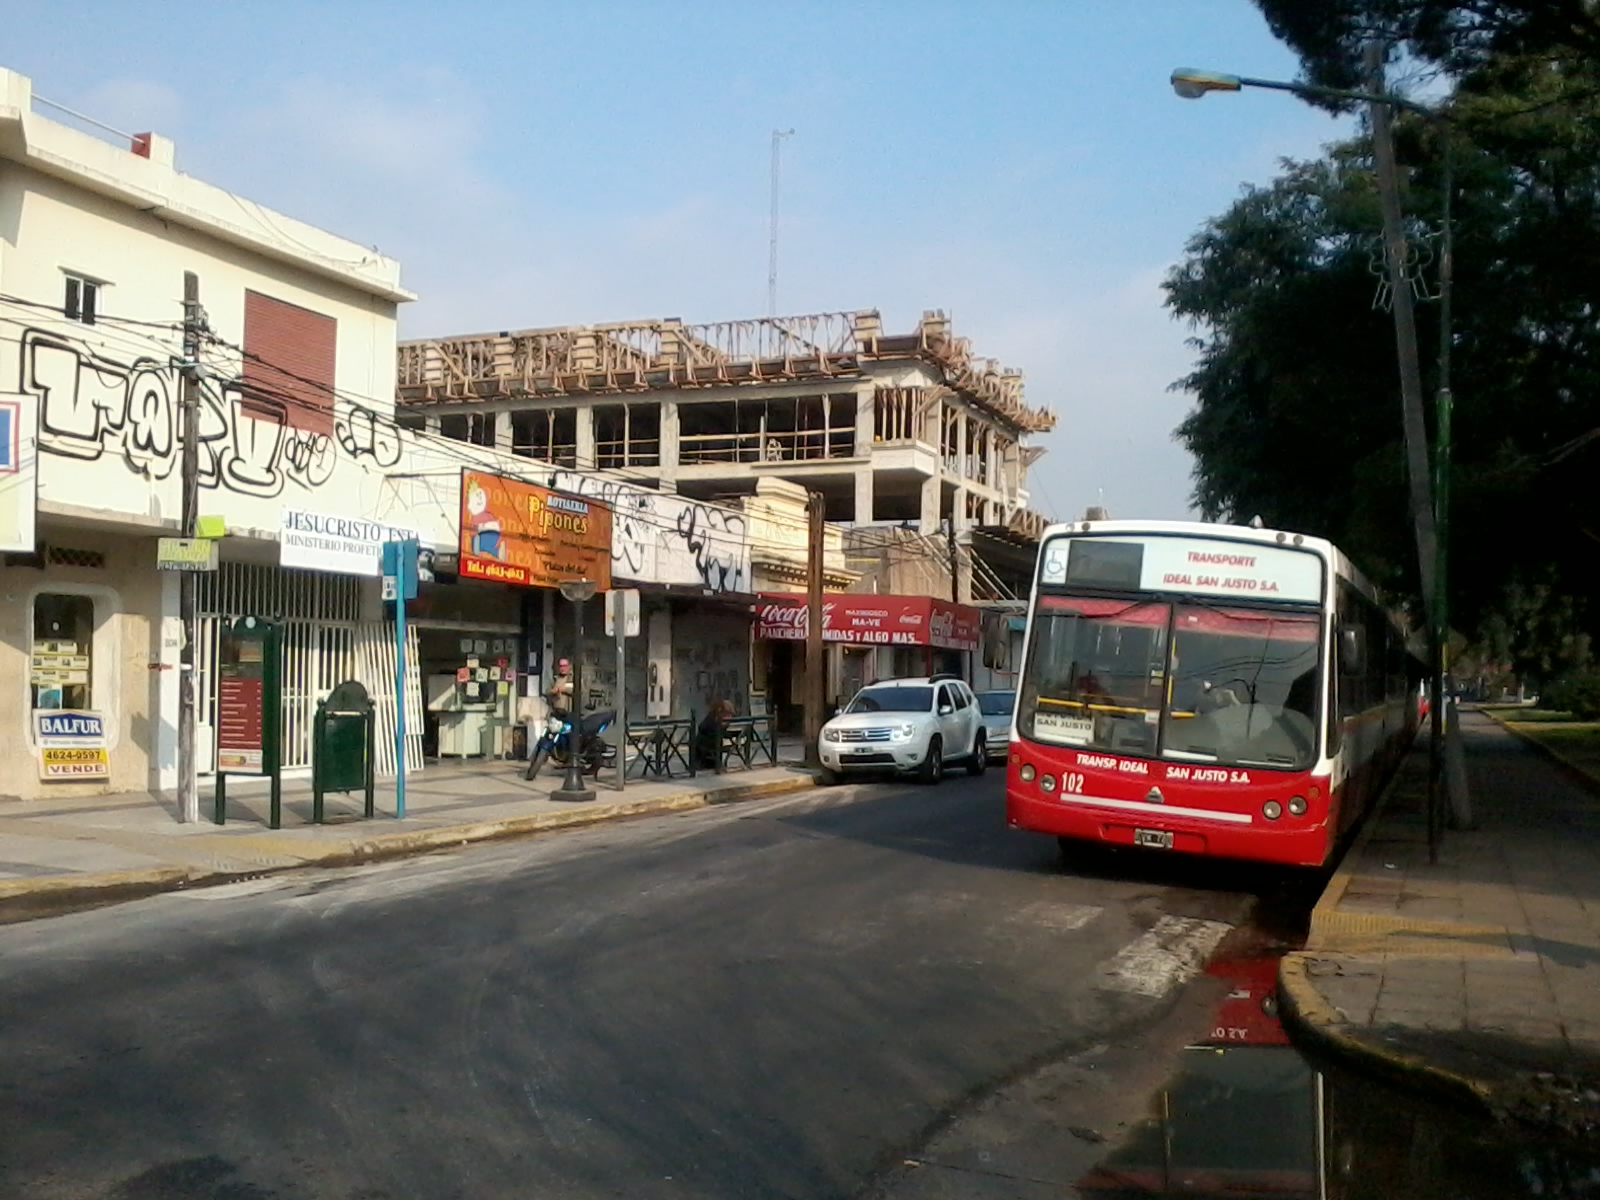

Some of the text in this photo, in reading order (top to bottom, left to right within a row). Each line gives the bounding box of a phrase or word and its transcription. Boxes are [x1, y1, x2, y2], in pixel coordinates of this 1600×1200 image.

[528, 495, 588, 535] Pipones
[285, 511, 380, 542] JESUCRISTO
[285, 533, 341, 552] MINISTERIO
[1187, 551, 1257, 567] TRANSPORTE
[1163, 573, 1279, 592] IDEAL SAN JUSTO S.A.
[862, 631, 889, 643] ALGO
[40, 718, 102, 734] BALFUR
[1036, 718, 1092, 731] SAN JUSTO
[49, 764, 104, 774] VENDE
[1077, 754, 1250, 783] TRANSP. IDEAL SAN JUSTO S.A.
[1061, 772, 1084, 793] 102
